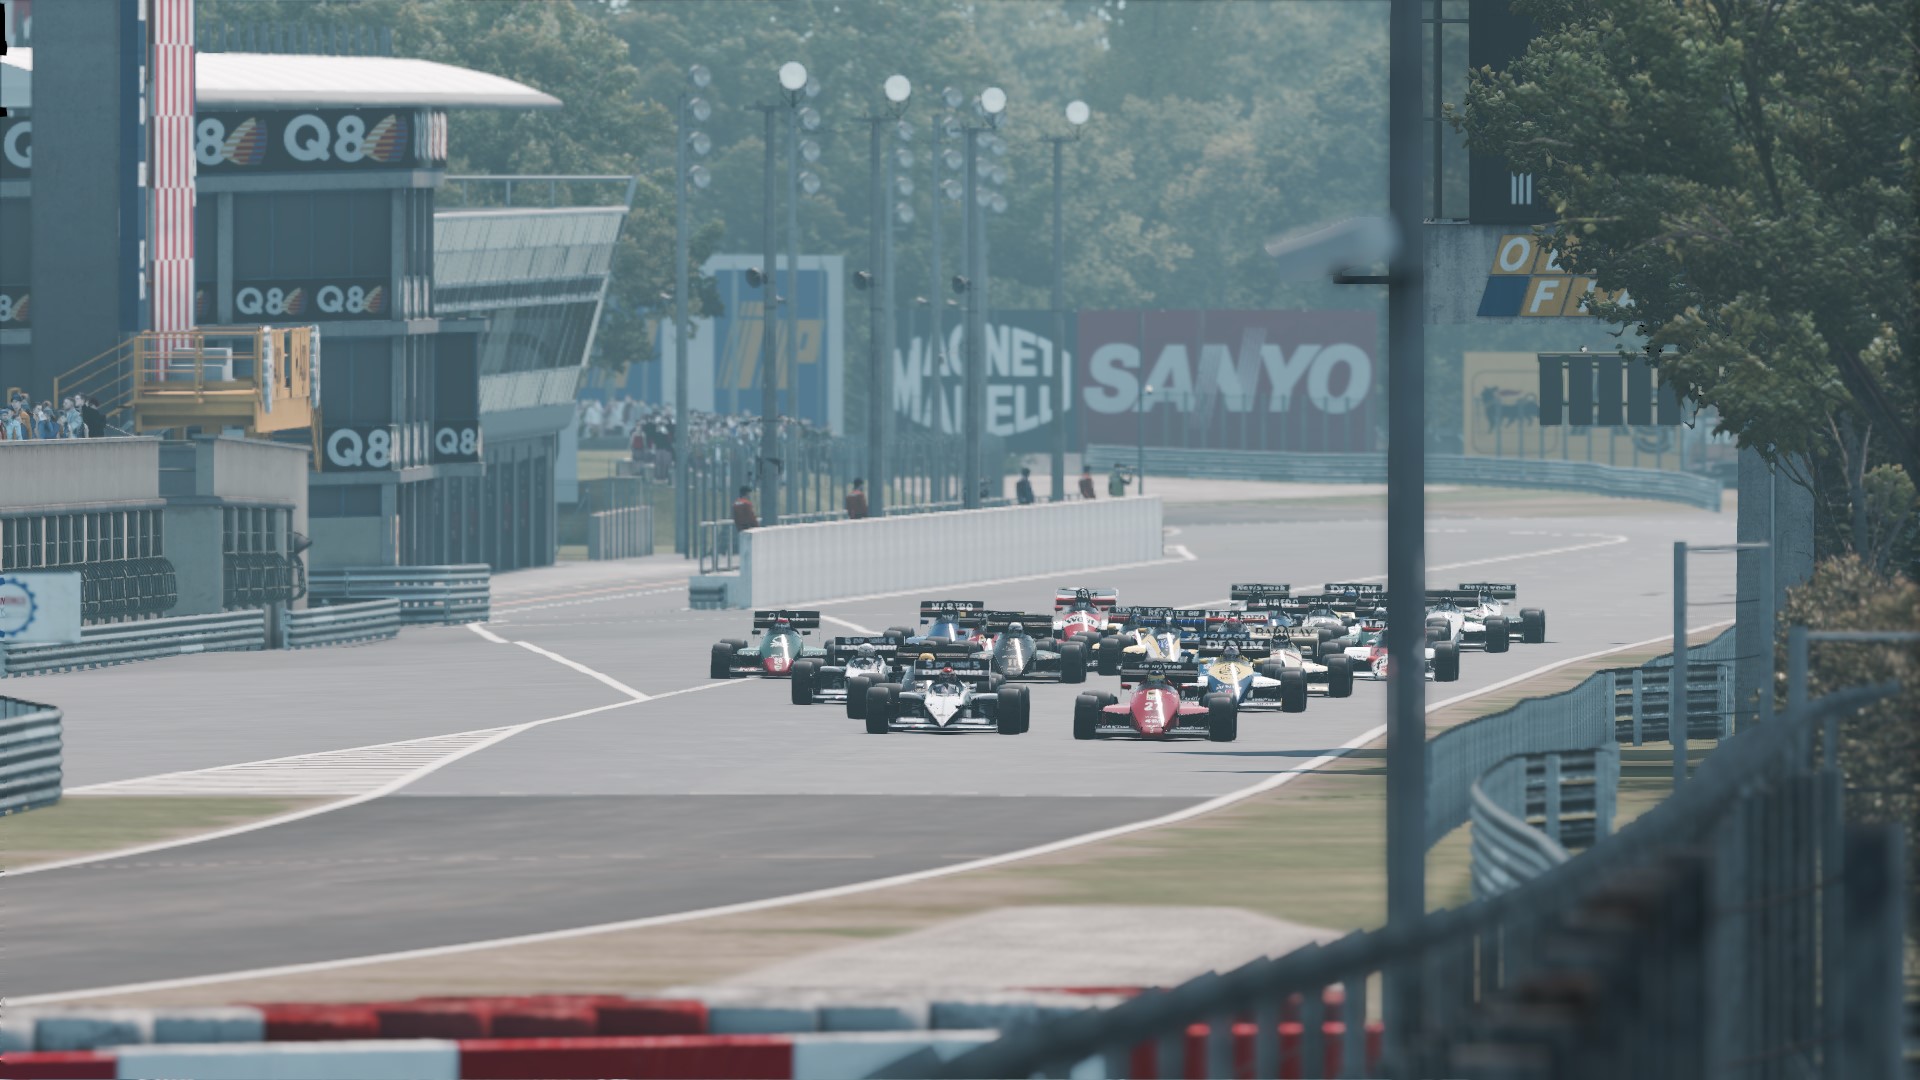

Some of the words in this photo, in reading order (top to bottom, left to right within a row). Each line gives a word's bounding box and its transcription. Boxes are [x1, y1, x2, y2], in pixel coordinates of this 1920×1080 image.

[283, 113, 365, 163] Q8
[236, 287, 284, 316] Q8
[316, 285, 365, 314] Q8
[1083, 343, 1371, 414] SANYO
[326, 428, 391, 468] Q8
[434, 432, 475, 456] Q8
